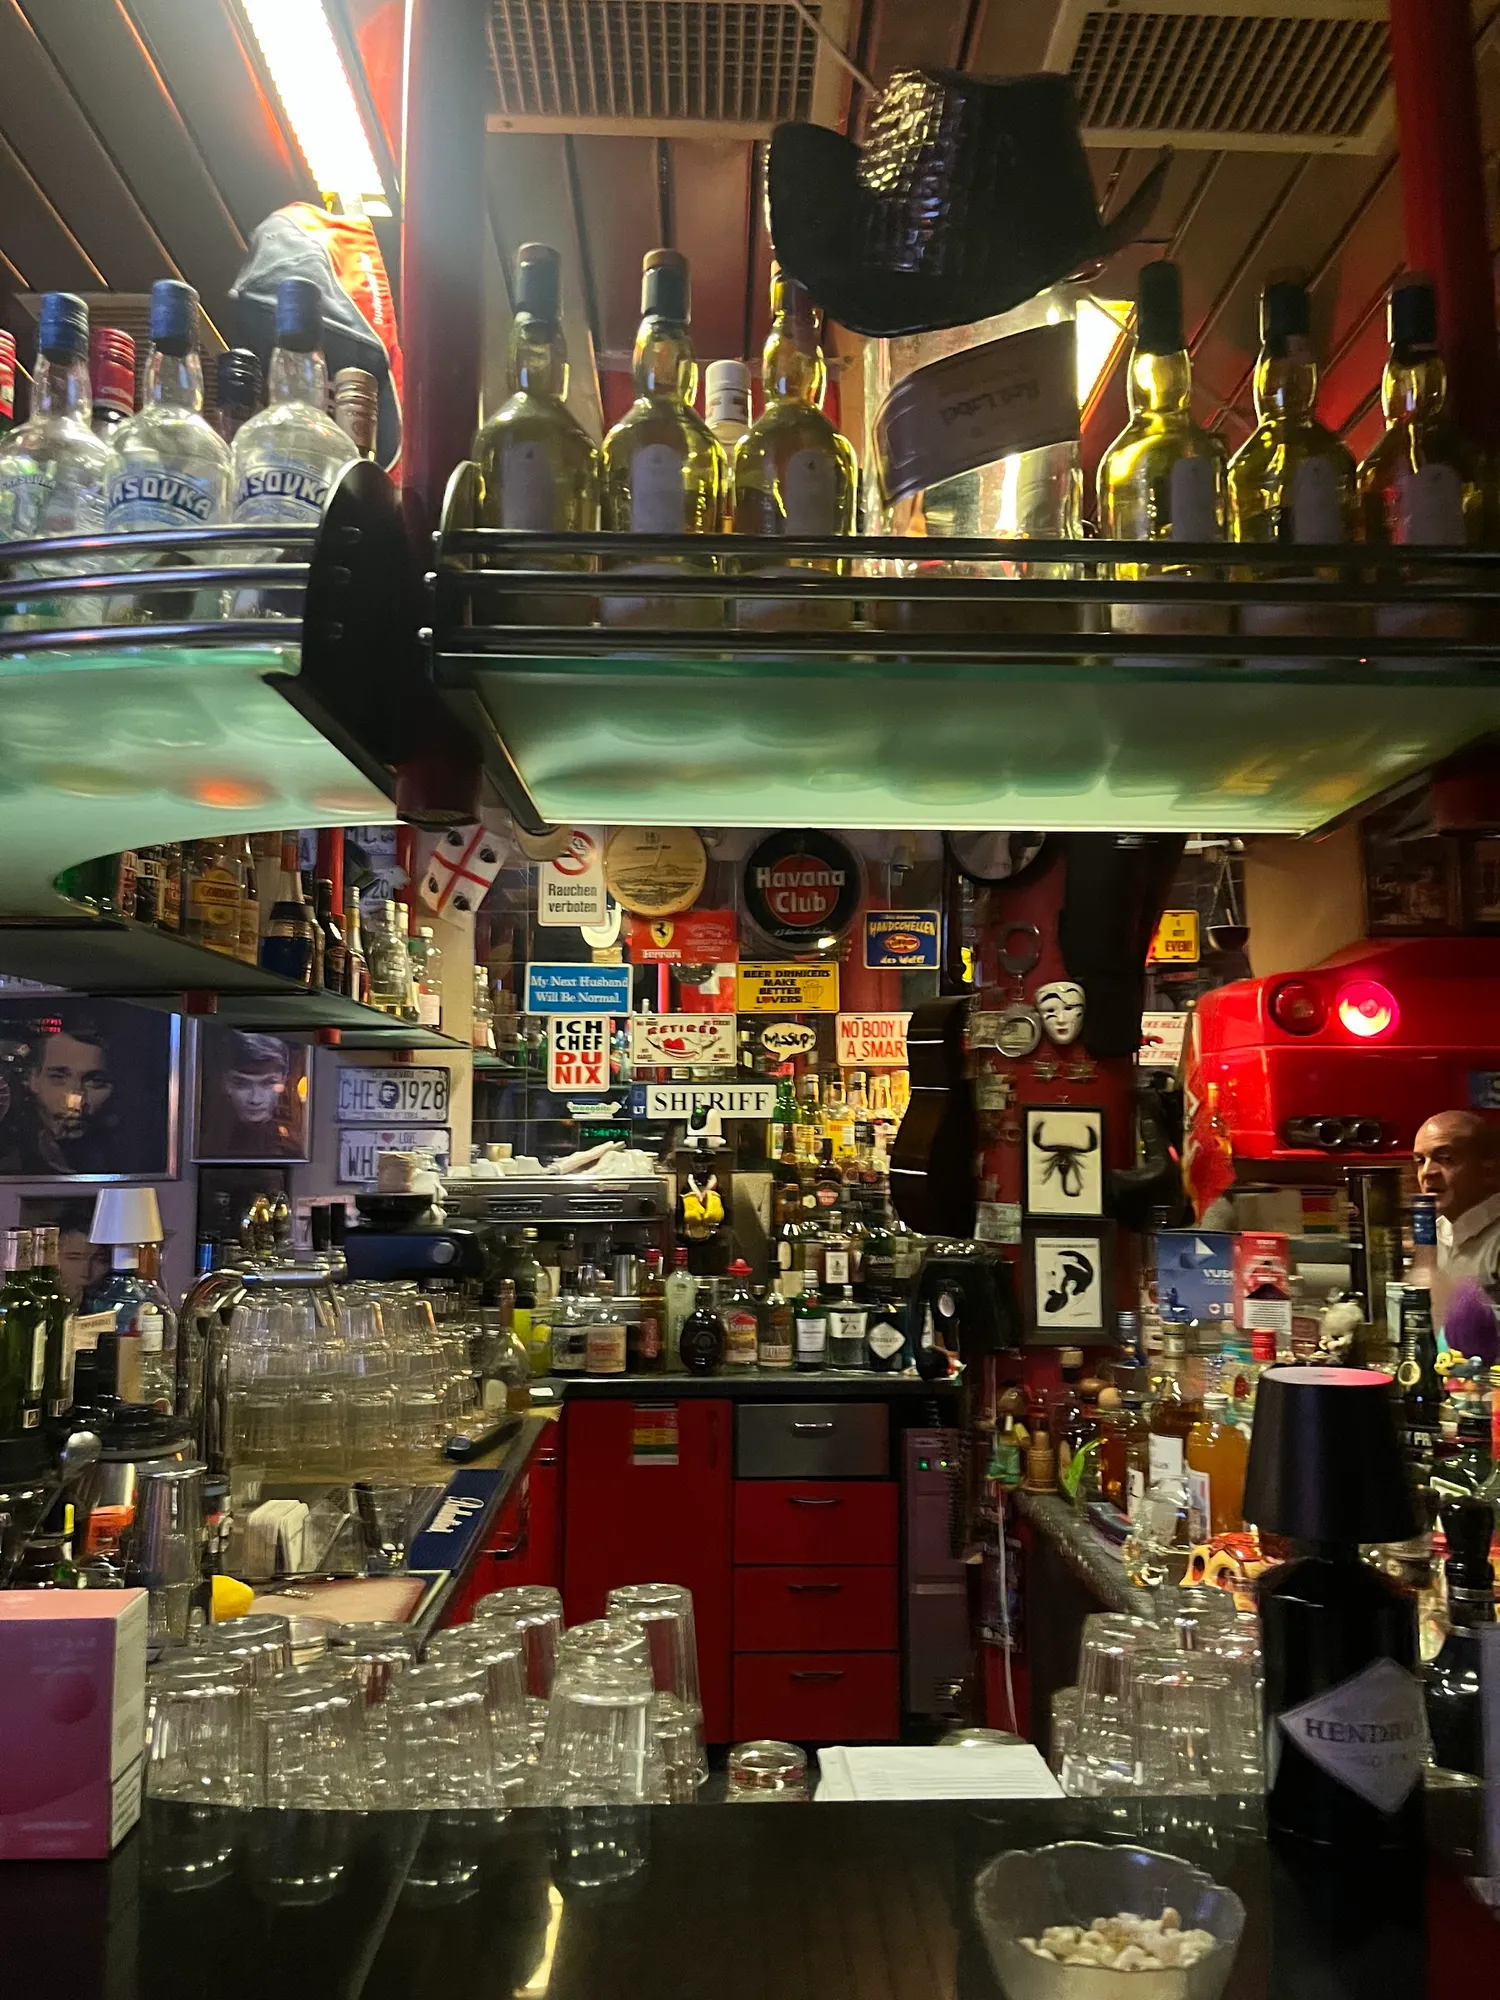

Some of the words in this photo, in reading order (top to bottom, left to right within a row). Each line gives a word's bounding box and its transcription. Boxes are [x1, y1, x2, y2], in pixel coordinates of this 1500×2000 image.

[756, 867, 845, 888] Havana
[548, 883, 597, 897] Rauchen
[548, 901, 597, 913] verboten
[776, 891, 826, 913] Club
[743, 970, 771, 978] BEER
[775, 969, 830, 978] DRINKERS
[531, 975, 549, 988] My
[550, 975, 577, 987] Next
[579, 975, 628, 988] Husband
[763, 978, 796, 986] MAKE
[535, 991, 558, 1002] Will
[560, 991, 576, 1002] Be
[577, 992, 621, 1003] Normal.
[759, 987, 801, 995] BETTER
[556, 1021, 602, 1034] ICH
[647, 1024, 717, 1035] RETIRED
[556, 1035, 602, 1050] CHEF
[847, 1042, 857, 1058] A
[862, 1041, 906, 1058] SMAR
[555, 1051, 602, 1065] DU
[555, 1066, 602, 1084] NIX
[340, 1080, 376, 1110] CHE
[402, 1080, 445, 1110] 1928
[654, 1092, 770, 1112] SHERIFF
[633, 1105, 646, 1115] LT
